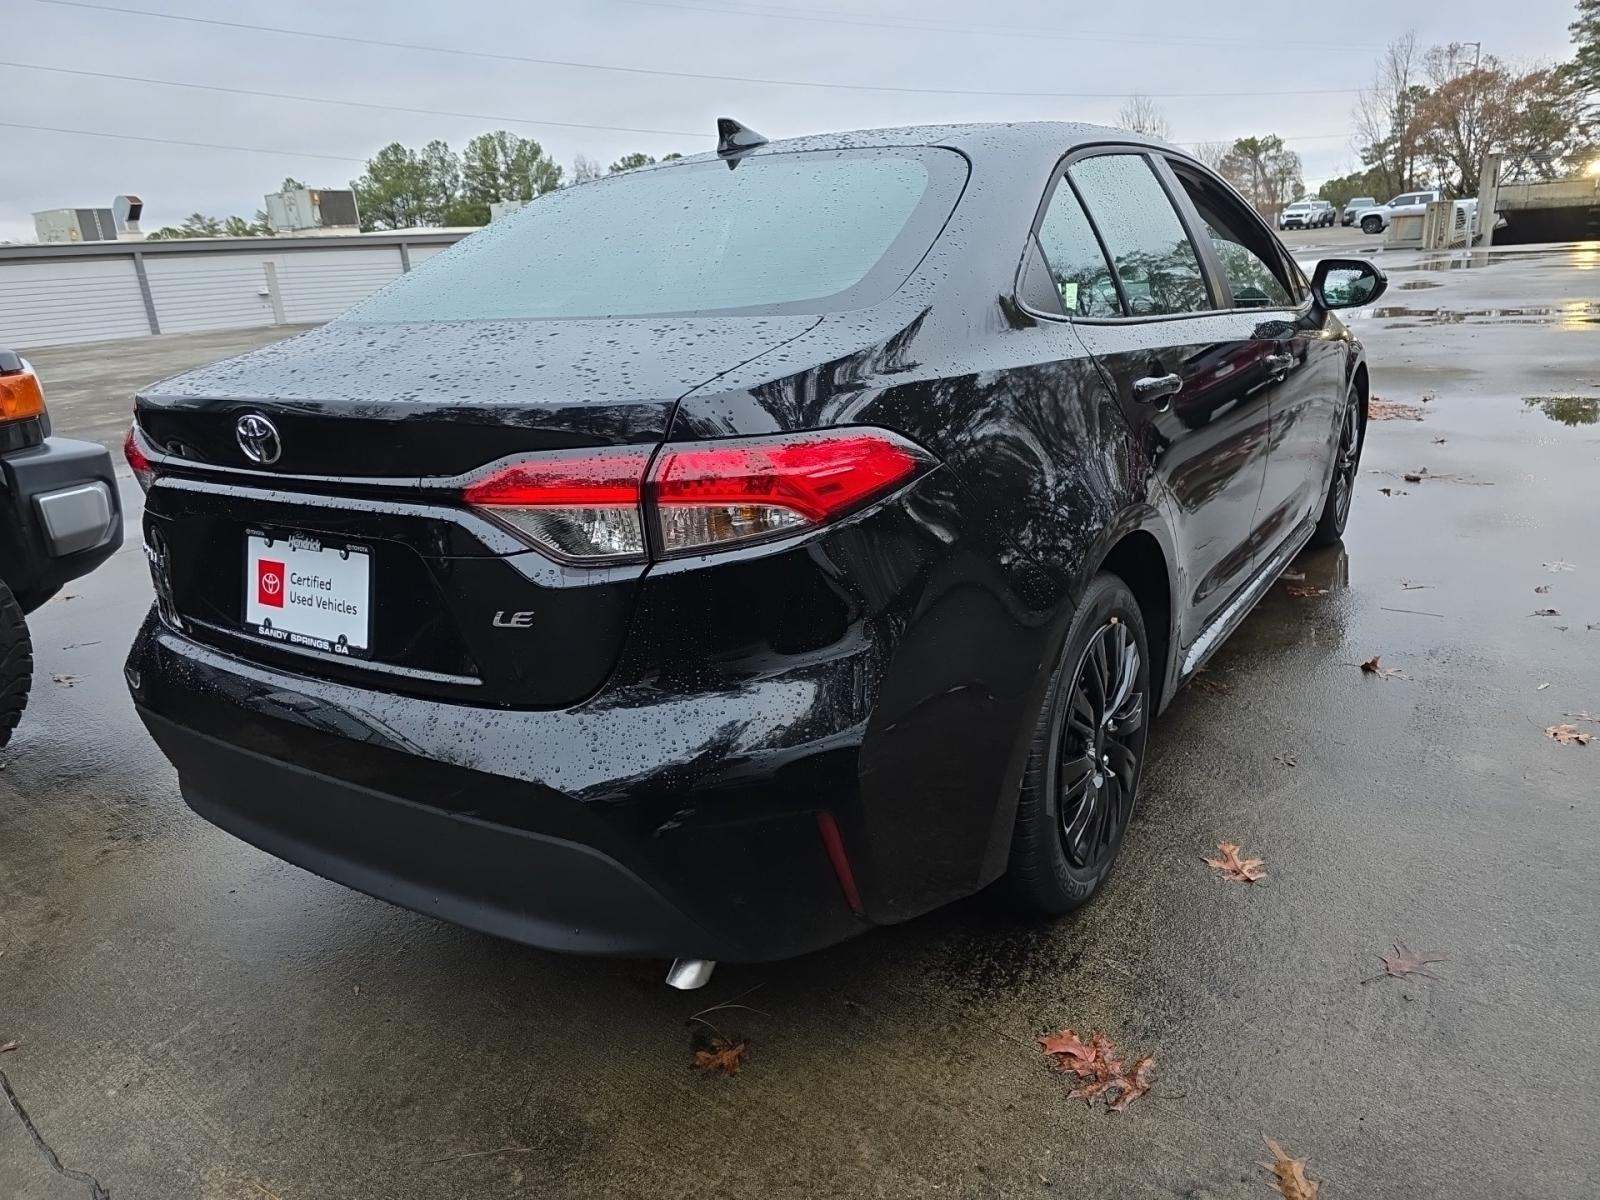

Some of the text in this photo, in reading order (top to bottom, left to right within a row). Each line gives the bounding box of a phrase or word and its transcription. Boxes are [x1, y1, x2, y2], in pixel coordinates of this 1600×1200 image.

[288, 535, 321, 552] Hendrick
[352, 545, 369, 553] TOYOTA
[290, 572, 332, 591] Certified
[290, 591, 358, 616] Used Vehicles
[492, 611, 535, 628] LE
[258, 626, 349, 655] SANDY SPRINGS, GA
